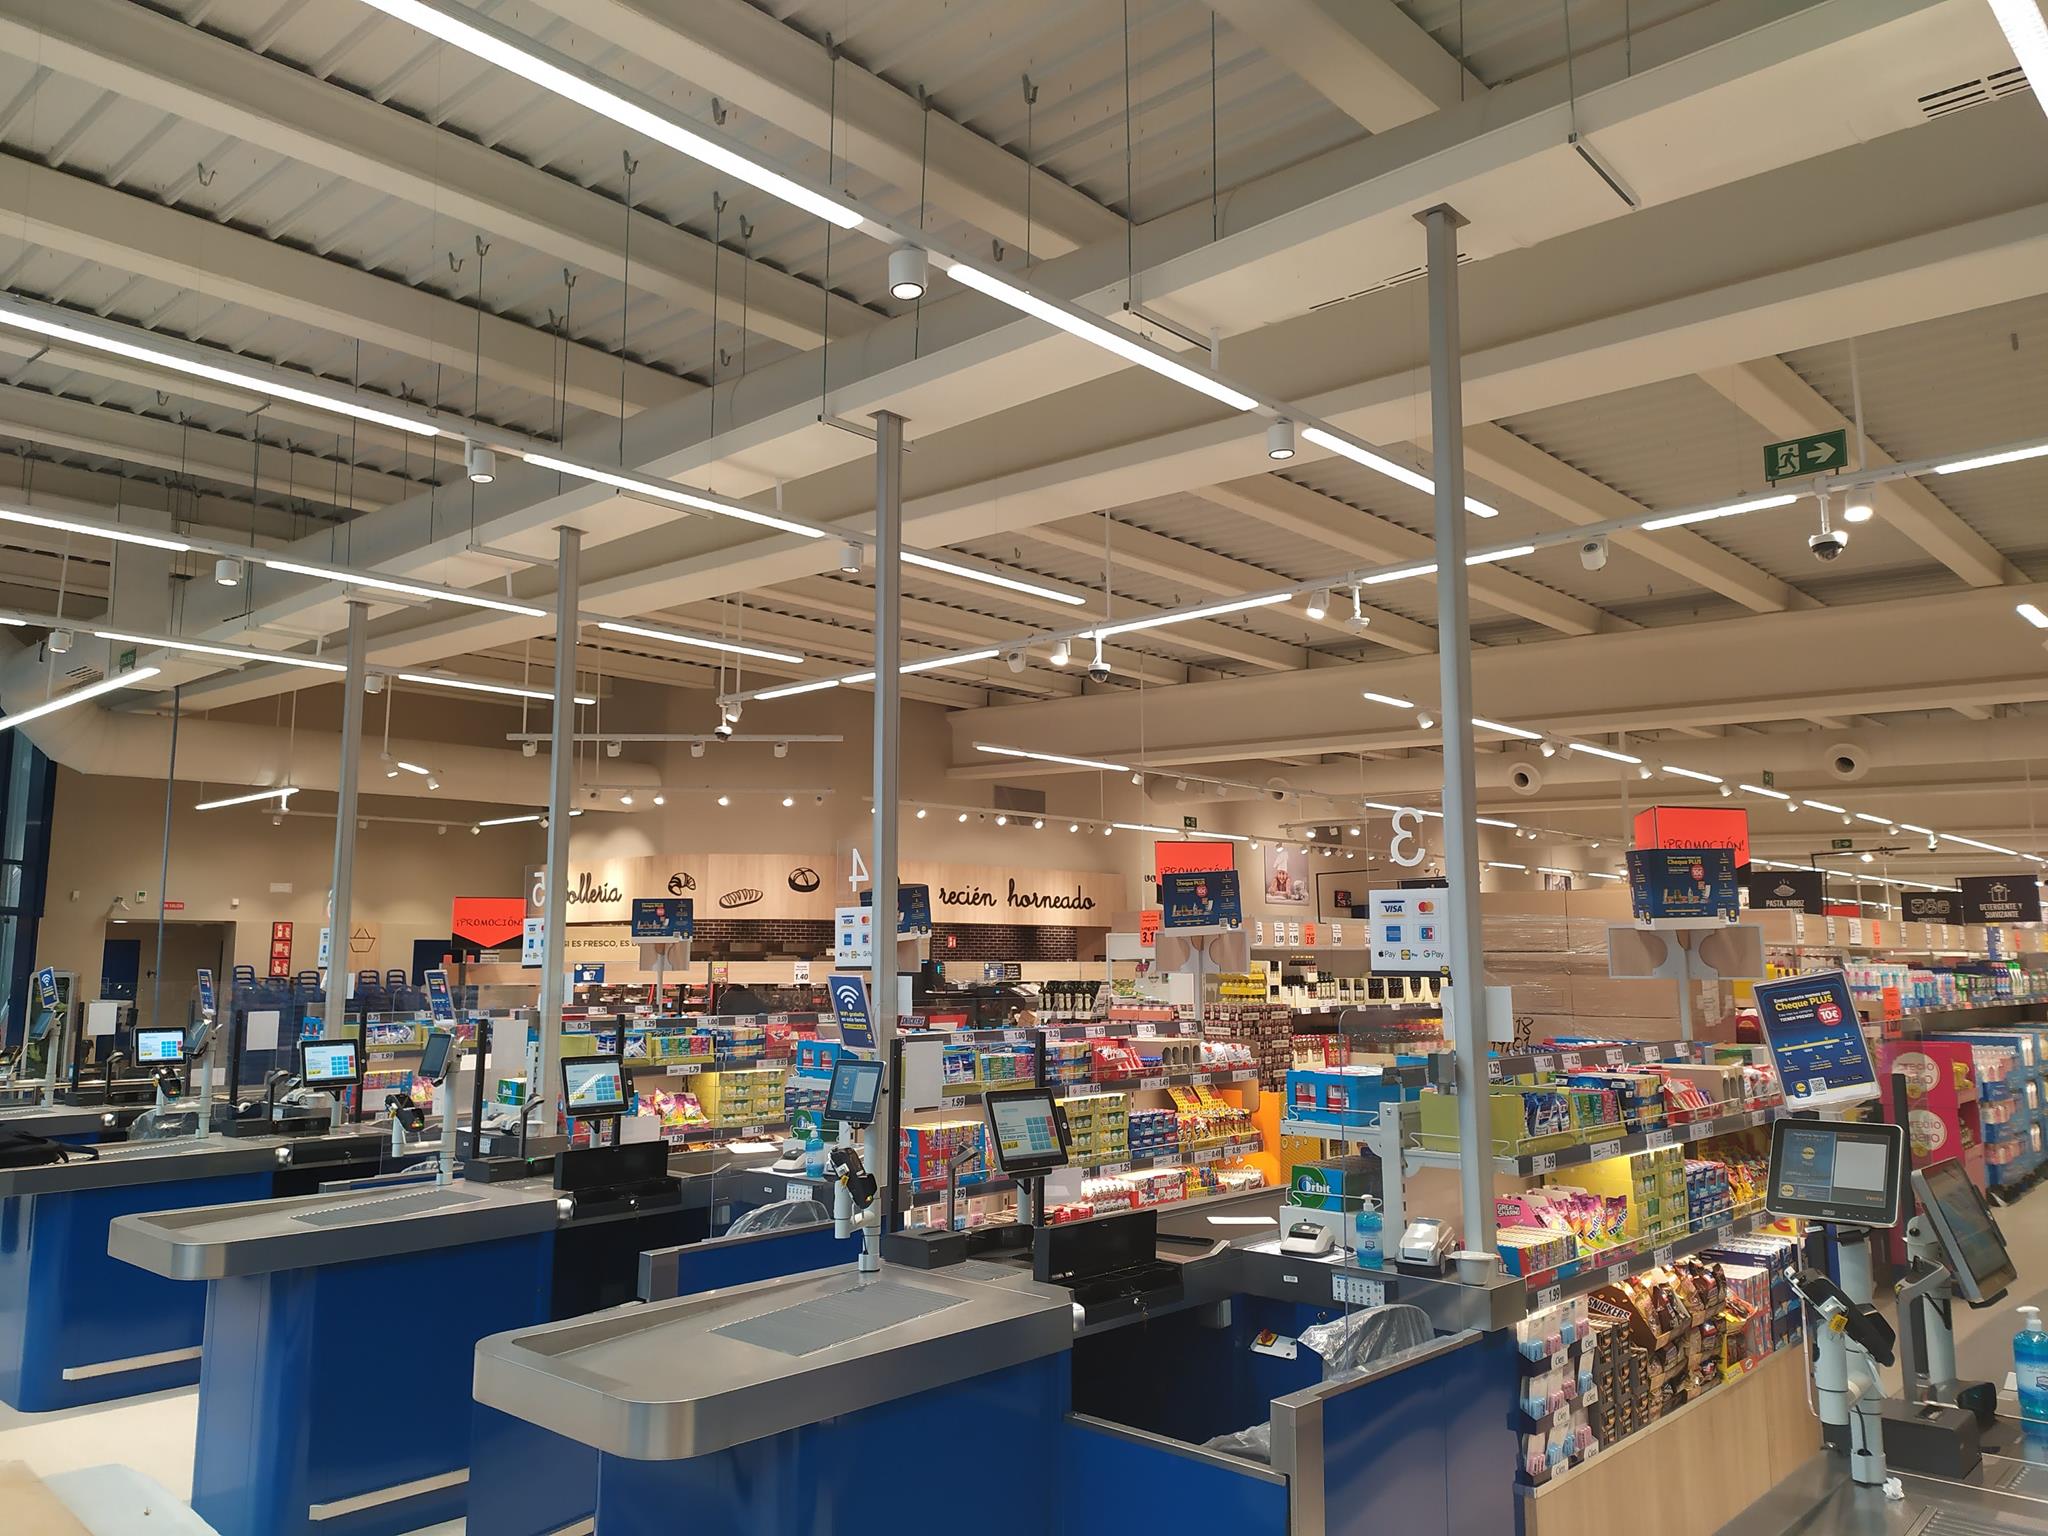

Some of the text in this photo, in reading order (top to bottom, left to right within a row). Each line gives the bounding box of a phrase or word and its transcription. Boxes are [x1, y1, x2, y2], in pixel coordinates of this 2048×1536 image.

[567, 872, 622, 905] ollería
[939, 878, 1096, 910] recién horneado
[1766, 900, 1785, 908] PASTA,
[1979, 903, 2017, 911] DETERGENTE
[1384, 905, 1403, 913] VISA
[572, 940, 582, 948] ES
[583, 940, 618, 949] FRESCO,
[1385, 950, 1397, 959] Pay
[1432, 950, 1444, 959] Pay
[1775, 1000, 1808, 1011] Cheque
[1809, 994, 1833, 1005] PLUS
[1820, 1010, 1839, 1020] 10€
[900, 1016, 925, 1027] SNICKERS
[962, 1034, 974, 1042] 1.29
[1014, 1031, 1025, 1040] 1.00
[1049, 1030, 1060, 1038] 0.29
[1488, 1062, 1500, 1073] 1.29
[951, 1097, 964, 1106] 1.99
[1543, 1157, 1555, 1169] 1.99
[1299, 1176, 1331, 1195] Orbit
[1497, 1203, 1515, 1211] GREAT
[1548, 1287, 1560, 1302] 1.99
[1588, 1297, 1630, 1320] SNICKERS
